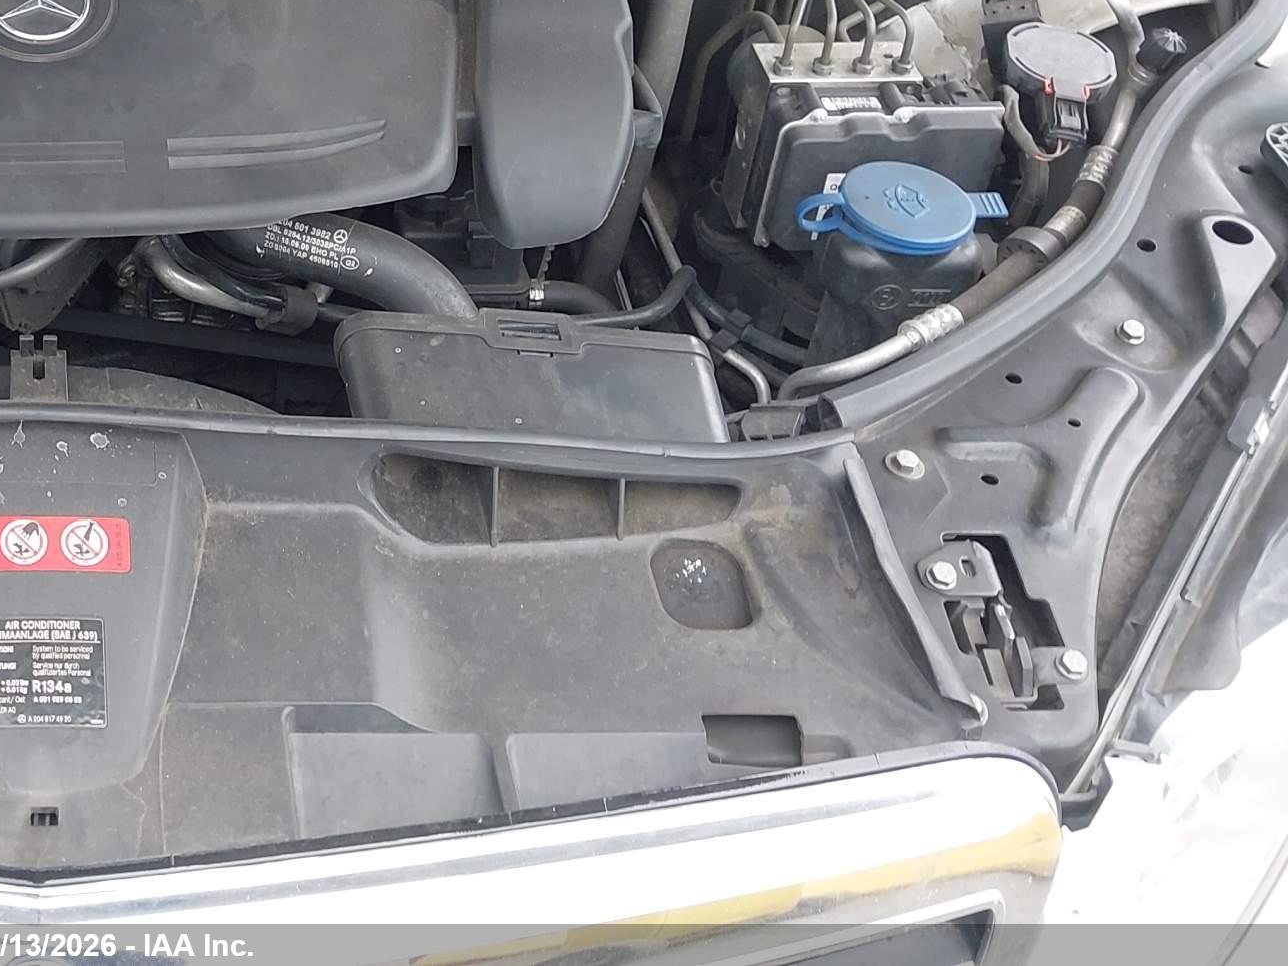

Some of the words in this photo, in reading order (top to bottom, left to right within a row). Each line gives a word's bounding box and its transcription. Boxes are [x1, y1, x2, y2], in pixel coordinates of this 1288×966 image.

[5, 621, 20, 630] AIR
[21, 621, 81, 630] CONDITIONER
[51, 631, 71, 641] (SAE
[78, 631, 98, 641] 639)
[32, 680, 72, 694] R134a
